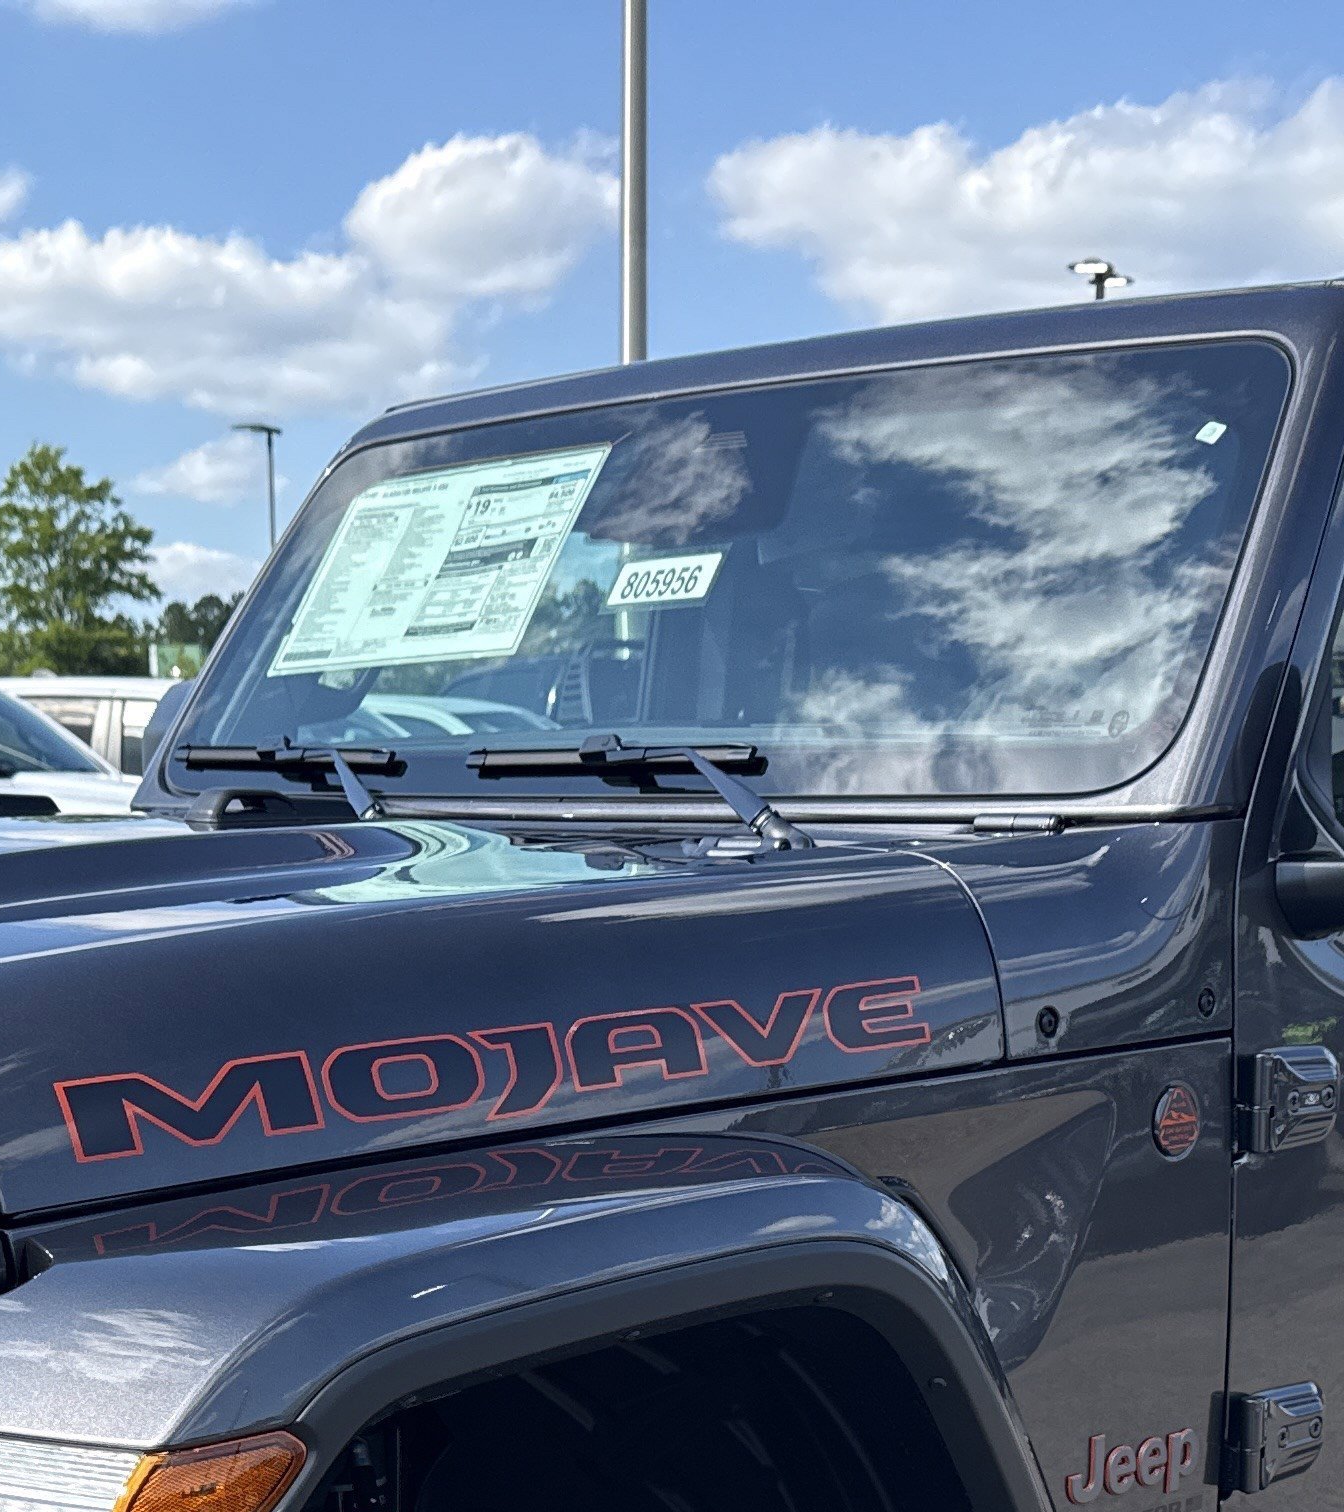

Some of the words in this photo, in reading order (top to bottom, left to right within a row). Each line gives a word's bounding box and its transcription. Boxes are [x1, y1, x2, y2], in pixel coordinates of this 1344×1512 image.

[620, 565, 703, 600] 805956
[54, 975, 931, 1163] MOJAVE
[1066, 1428, 1198, 1504] Jeep
